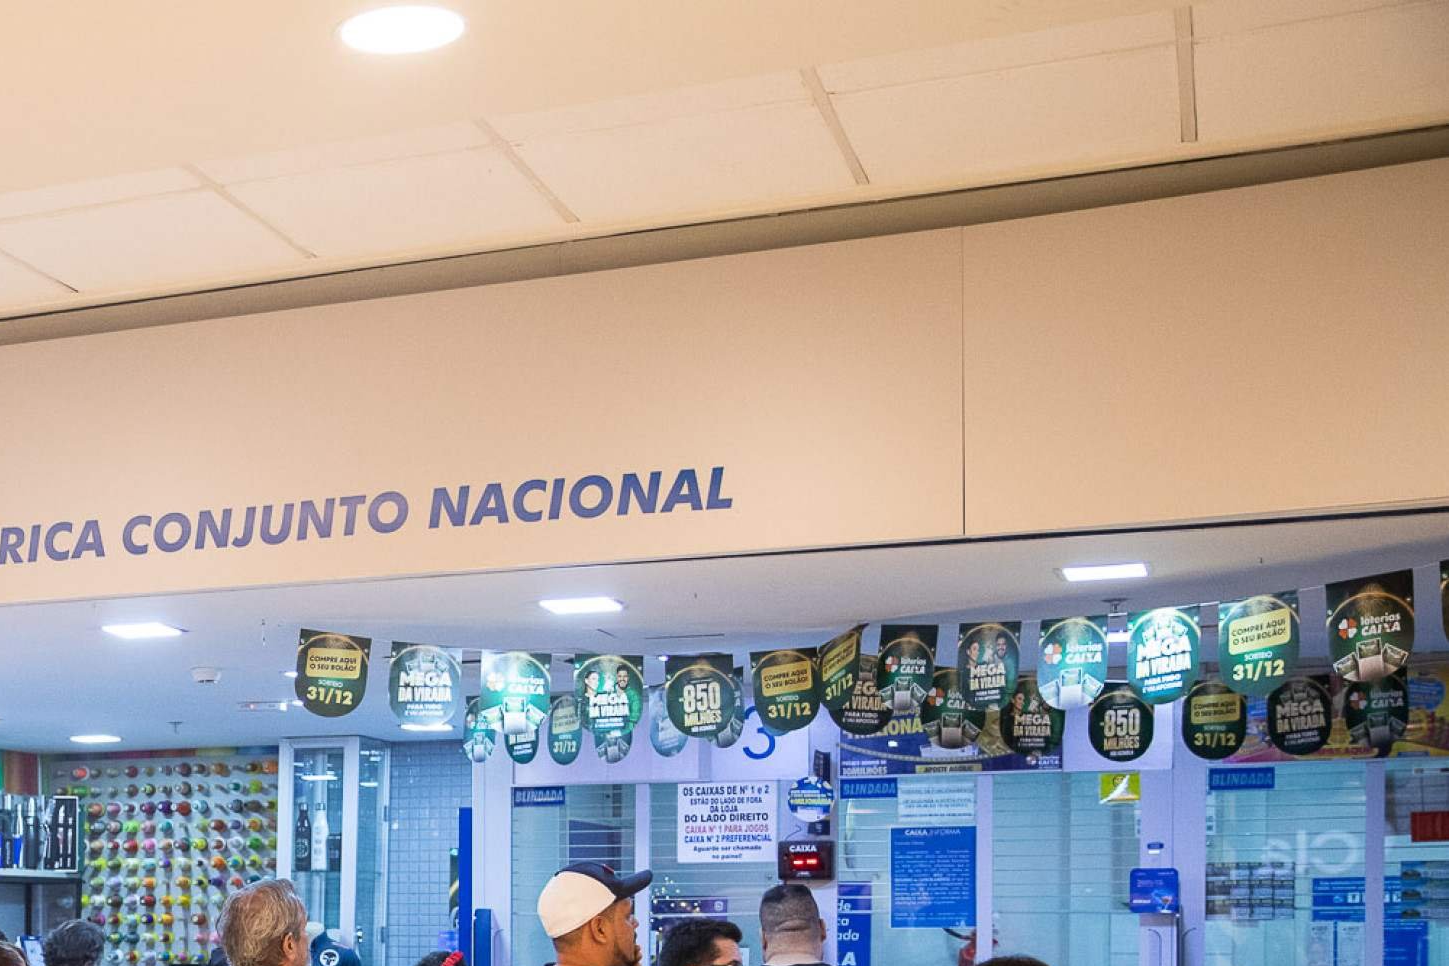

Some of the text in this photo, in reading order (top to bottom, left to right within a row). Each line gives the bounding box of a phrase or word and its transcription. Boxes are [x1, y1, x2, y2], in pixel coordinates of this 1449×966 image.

[121, 491, 411, 556] CONJUNTO
[427, 465, 734, 530] NACIONAL
[1360, 612, 1400, 625] loterias
[1231, 617, 1286, 637] COMPRE AQUI
[1361, 622, 1401, 636] CAIXA
[1241, 635, 1255, 644] SEU
[1256, 627, 1286, 641] BOLÃO!
[309, 655, 338, 664] COMPRE
[1065, 652, 1103, 664] CAIXA
[900, 664, 926, 675] CAIXA
[971, 661, 1006, 677] MEGA
[1232, 659, 1286, 681] 31/12
[399, 670, 453, 687] MEGA
[763, 669, 808, 683] COMPRE AQUI
[825, 672, 854, 701] 31/12
[306, 686, 353, 705] 31/12
[1275, 699, 1324, 719] MEGA
[1370, 698, 1404, 708] CAIXA
[767, 701, 812, 720] 31/12
[1014, 713, 1051, 726] MEGA
[1193, 732, 1236, 748] 31/12
[1212, 773, 1273, 785] BLINDADA
[516, 789, 563, 803] BLINDADA
[683, 787, 694, 797] OS
[695, 786, 725, 796] CAIXAS
[726, 786, 738, 795] DE
[750, 786, 755, 794] 1
[764, 785, 770, 794] 2
[843, 783, 897, 796] BLINDADA
[690, 796, 762, 806] ESTÃO DO LADO DE FORA
[710, 805, 738, 813] DA LOJA
[684, 812, 769, 823] DO LADO DIREITO
[685, 825, 707, 834] CAIXA
[724, 824, 743, 833] PARA
[744, 824, 769, 833] JOGOS
[684, 835, 705, 843] CAIXA
[721, 833, 772, 843] PREFERENCIAL
[693, 845, 719, 853] Aguarde
[789, 844, 818, 852] CAIXA
